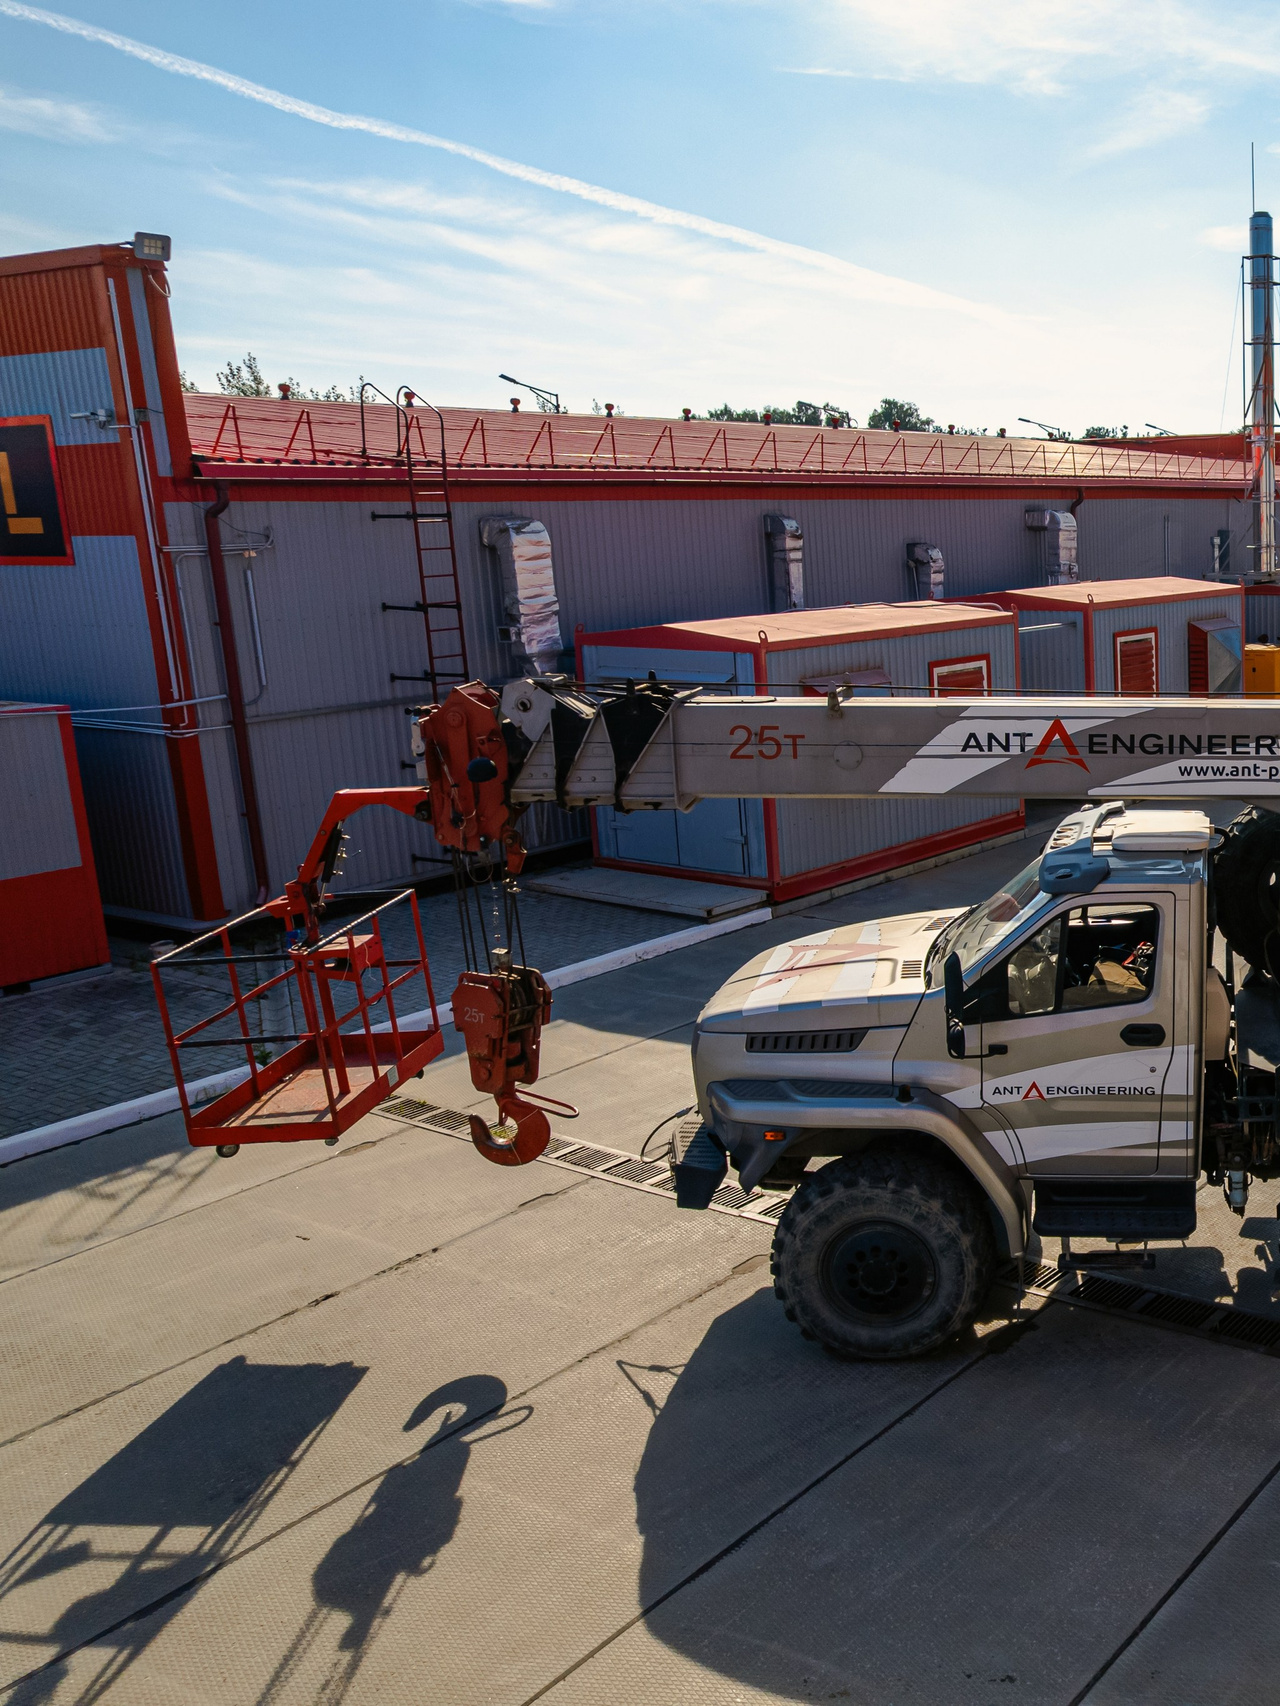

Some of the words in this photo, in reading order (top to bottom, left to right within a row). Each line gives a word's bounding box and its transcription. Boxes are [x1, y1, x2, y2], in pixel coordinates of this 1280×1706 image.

[961, 732, 1034, 752] ANT
[992, 1086, 1023, 1096] ANT
[1046, 1086, 1156, 1096] ENGINEERING
